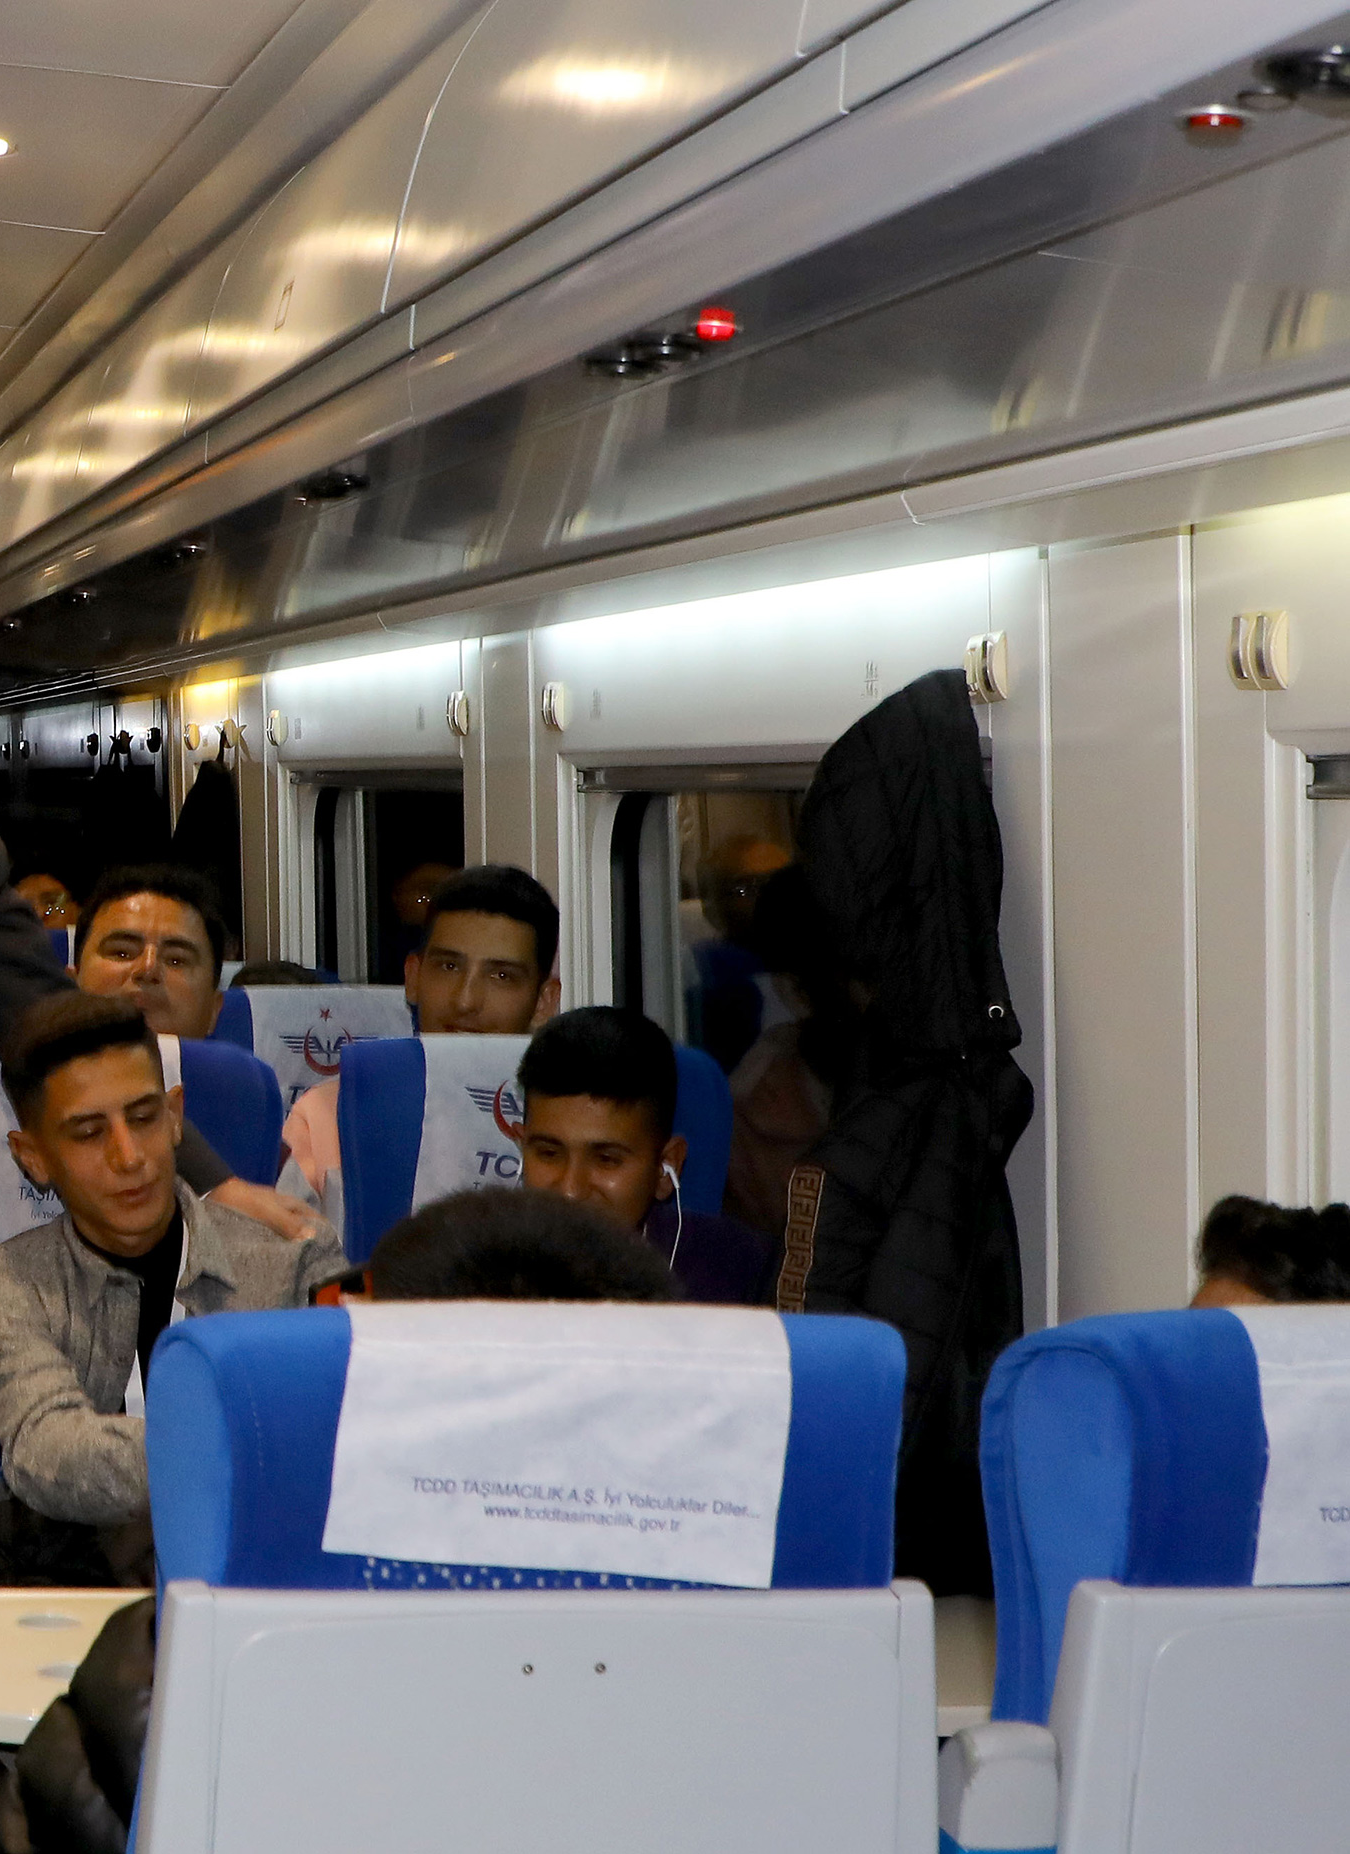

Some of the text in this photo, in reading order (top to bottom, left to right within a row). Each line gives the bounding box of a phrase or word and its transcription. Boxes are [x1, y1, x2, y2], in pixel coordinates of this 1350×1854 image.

[412, 1476, 457, 1494] TCDD
[462, 1478, 563, 1502] TAŞIMACILIK
[627, 1491, 707, 1514] Yolculuklar
